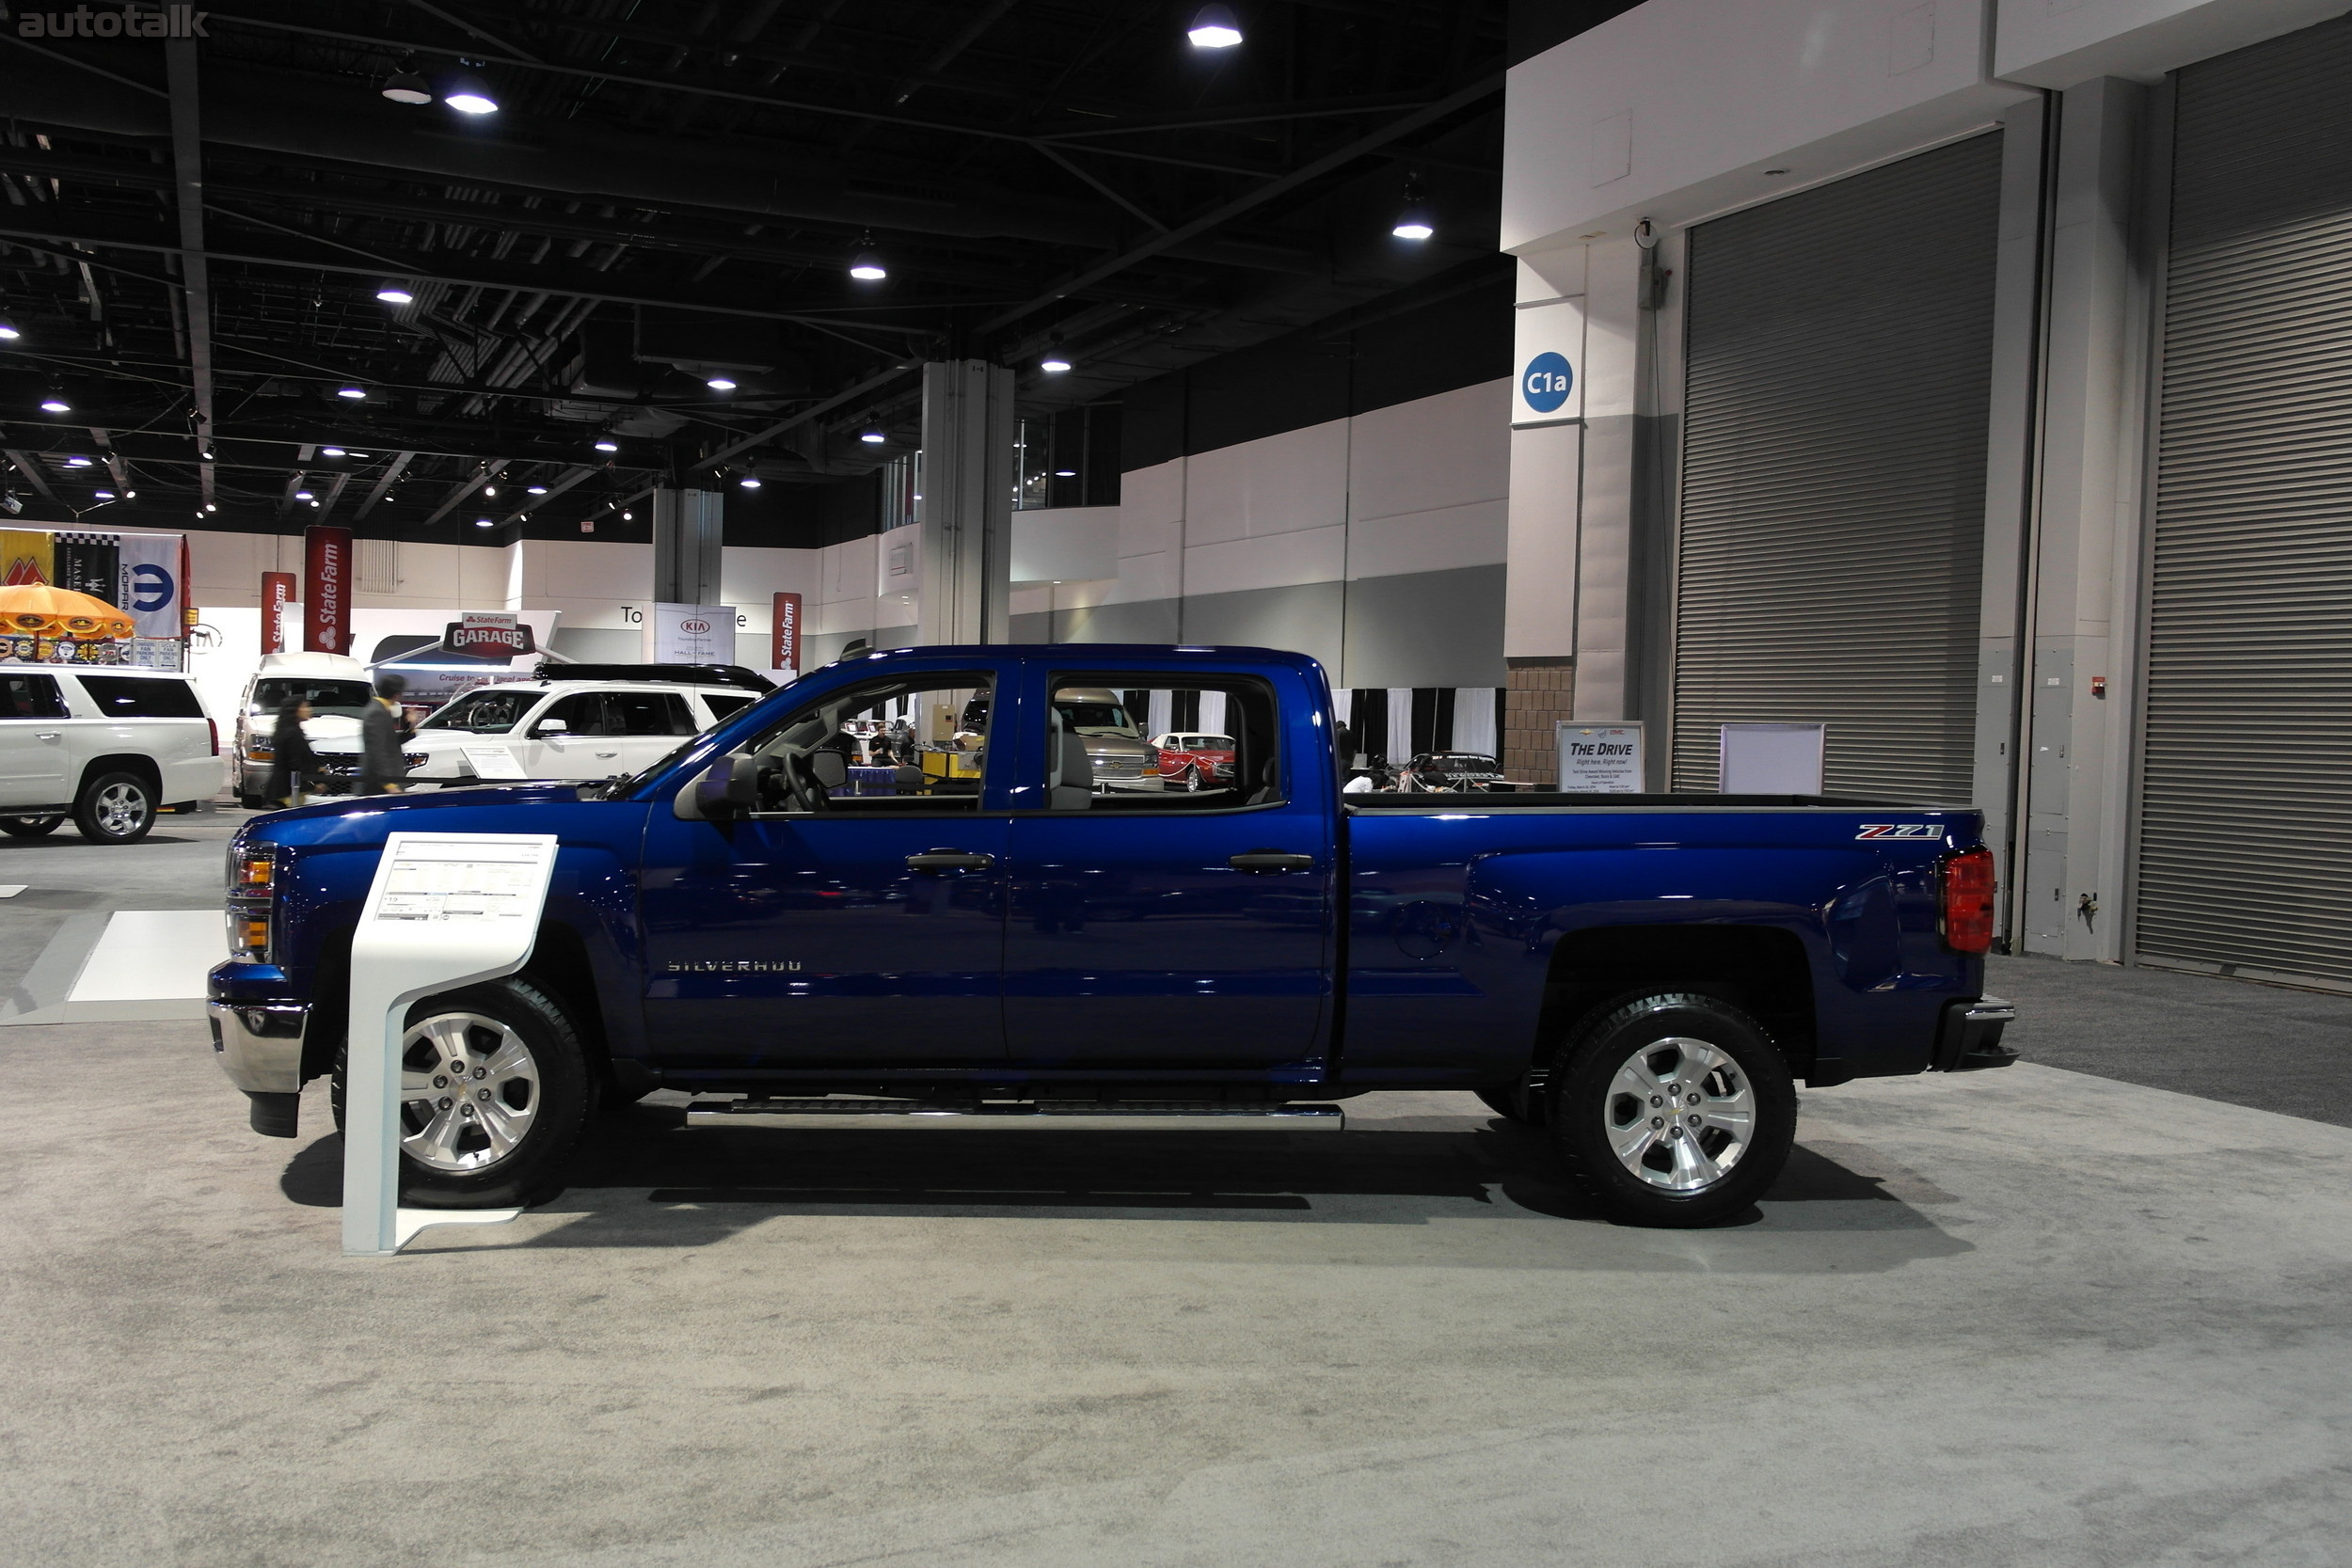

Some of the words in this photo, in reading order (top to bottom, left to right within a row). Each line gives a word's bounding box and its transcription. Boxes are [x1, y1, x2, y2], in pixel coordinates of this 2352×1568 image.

[1527, 372, 1566, 393] C1a
[453, 629, 523, 650] GARAGE
[439, 673, 465, 682] Cruise
[1571, 743, 1595, 755] THE
[1597, 743, 1633, 755] DRIVE
[1855, 824, 1945, 840] Z71
[667, 960, 802, 972] SILVERADO
